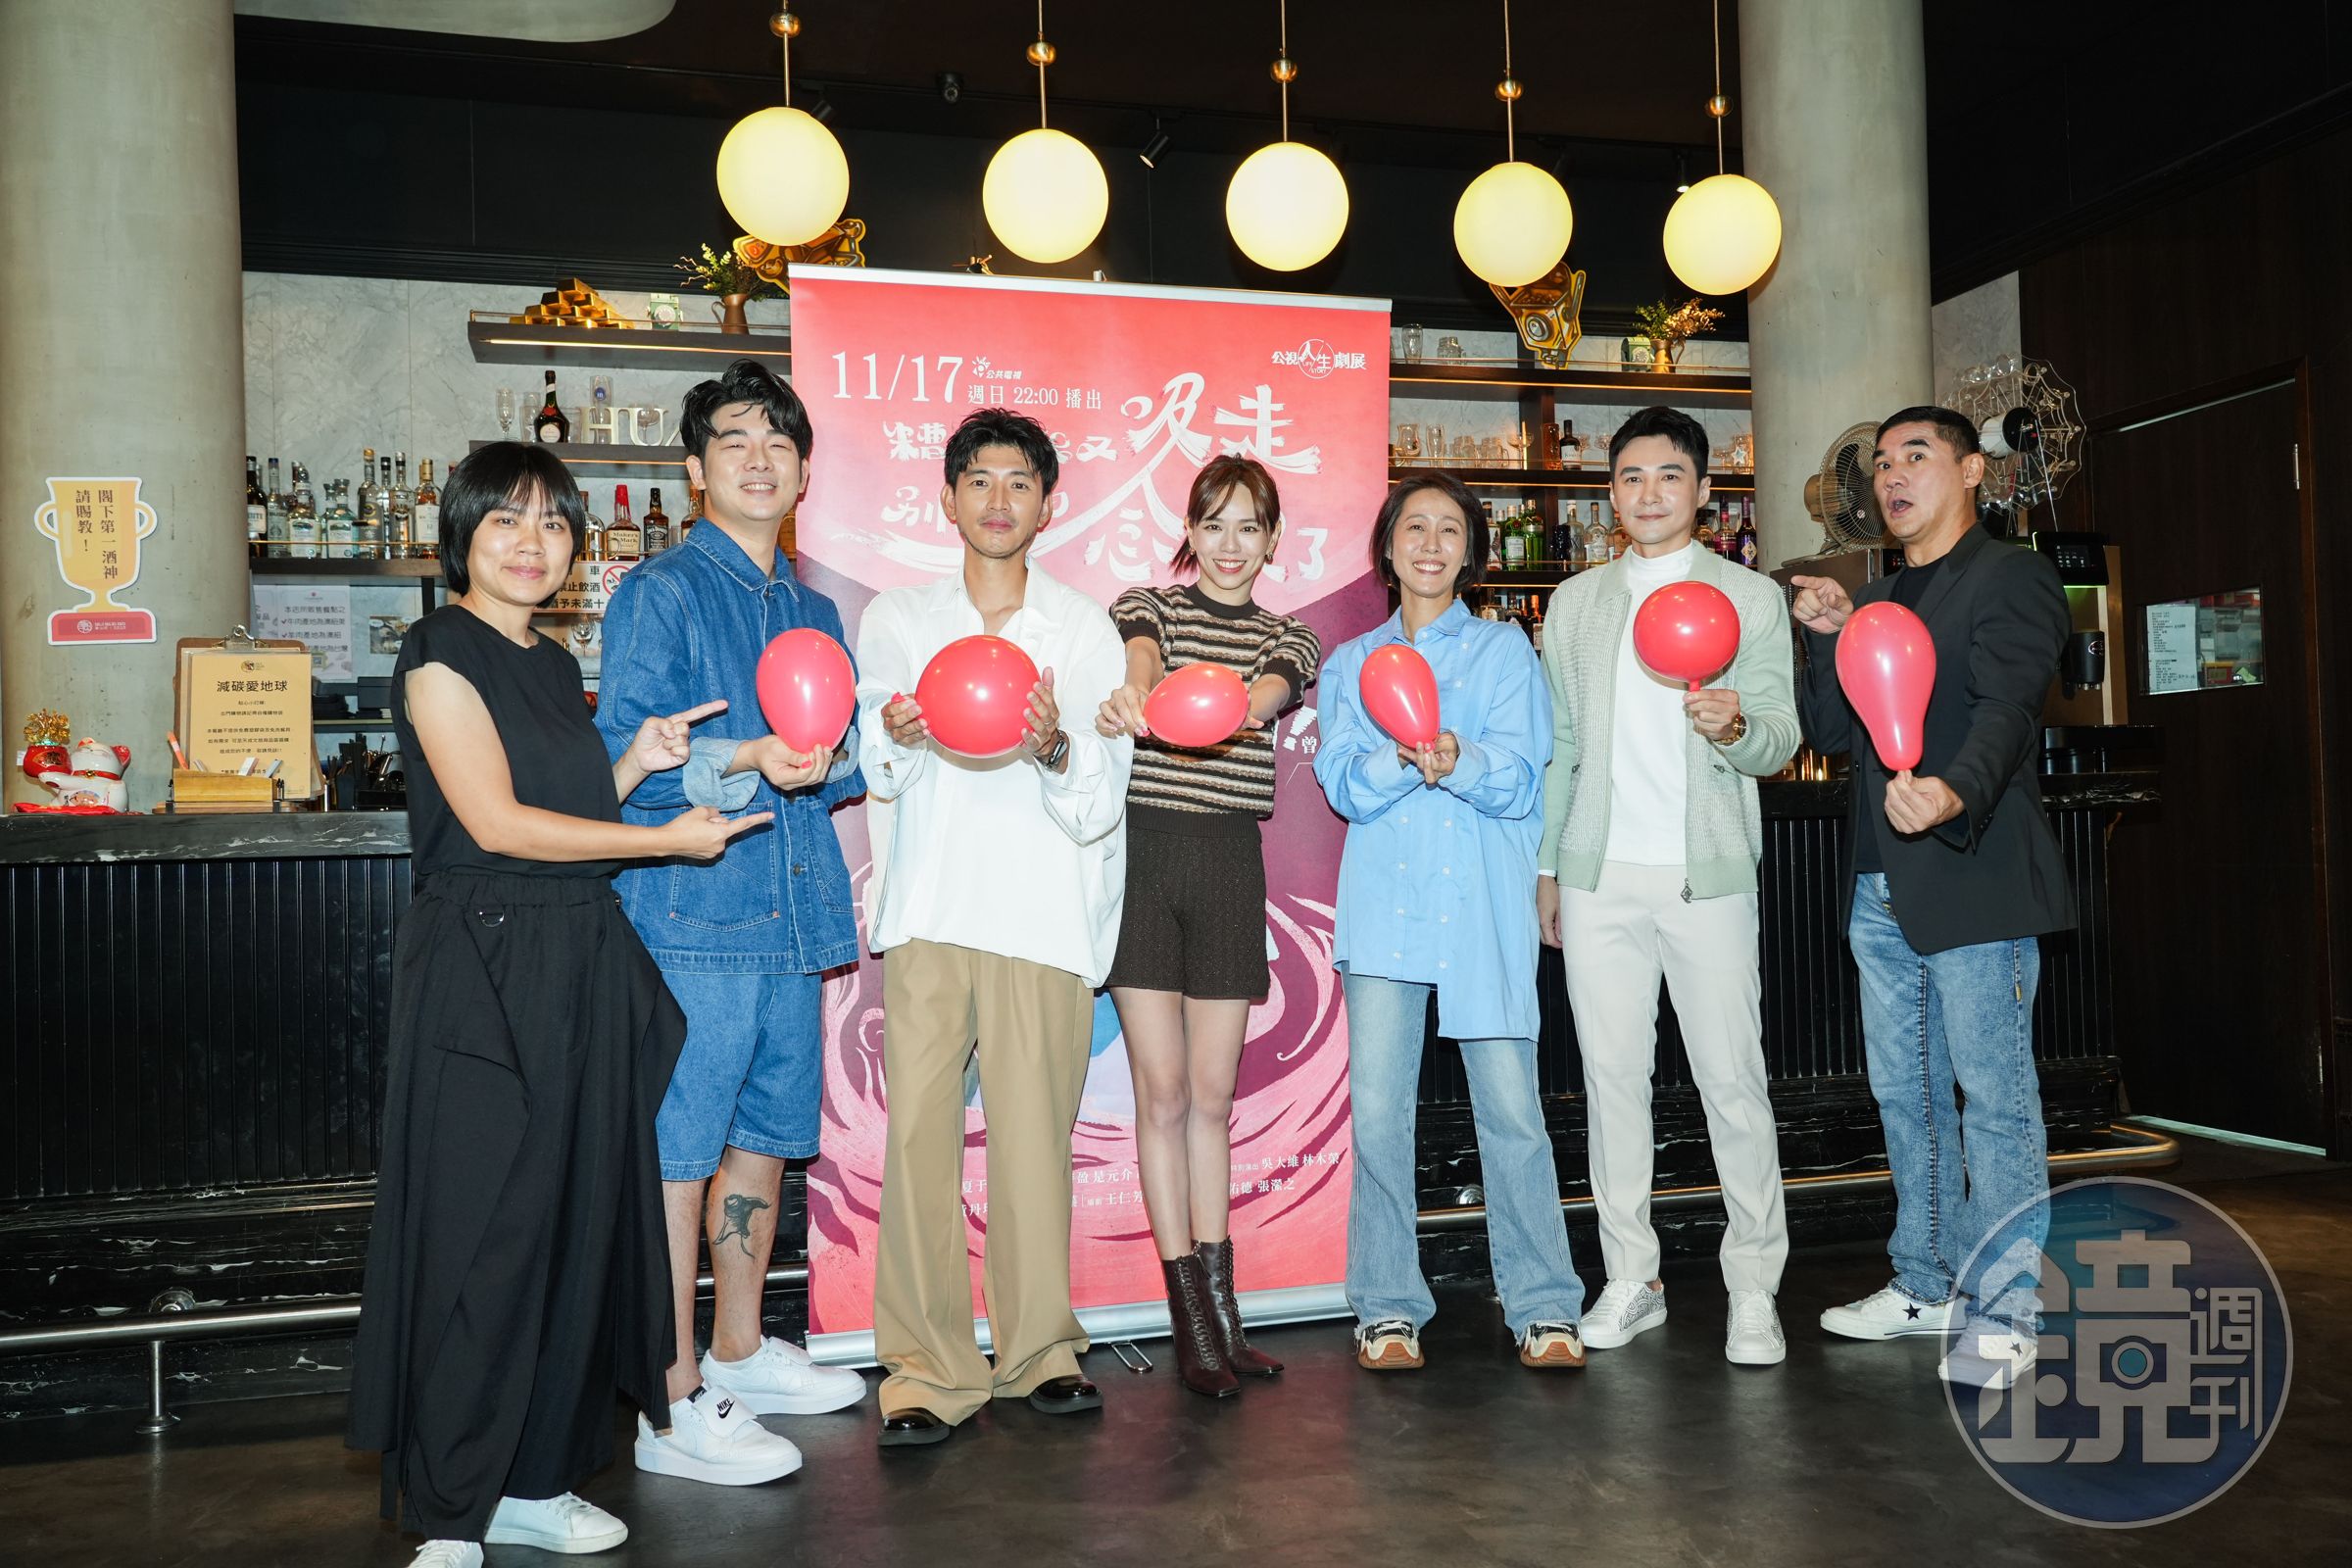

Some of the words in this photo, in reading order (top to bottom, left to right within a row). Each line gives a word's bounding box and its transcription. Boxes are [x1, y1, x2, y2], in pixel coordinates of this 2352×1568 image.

[832, 351, 963, 404] 11/17
[986, 369, 1022, 380] 公共電視
[967, 384, 1004, 405] 週日
[1013, 386, 1058, 406] 22:00
[1065, 388, 1102, 410] 播出
[580, 407, 681, 446] HU
[98, 490, 118, 579] 閣下第一酒神
[217, 680, 288, 693] 減碳愛地球
[1261, 1155, 1299, 1170] 吳大維
[1094, 1167, 1133, 1184] 是元介
[716, 1398, 732, 1411] NIKE
